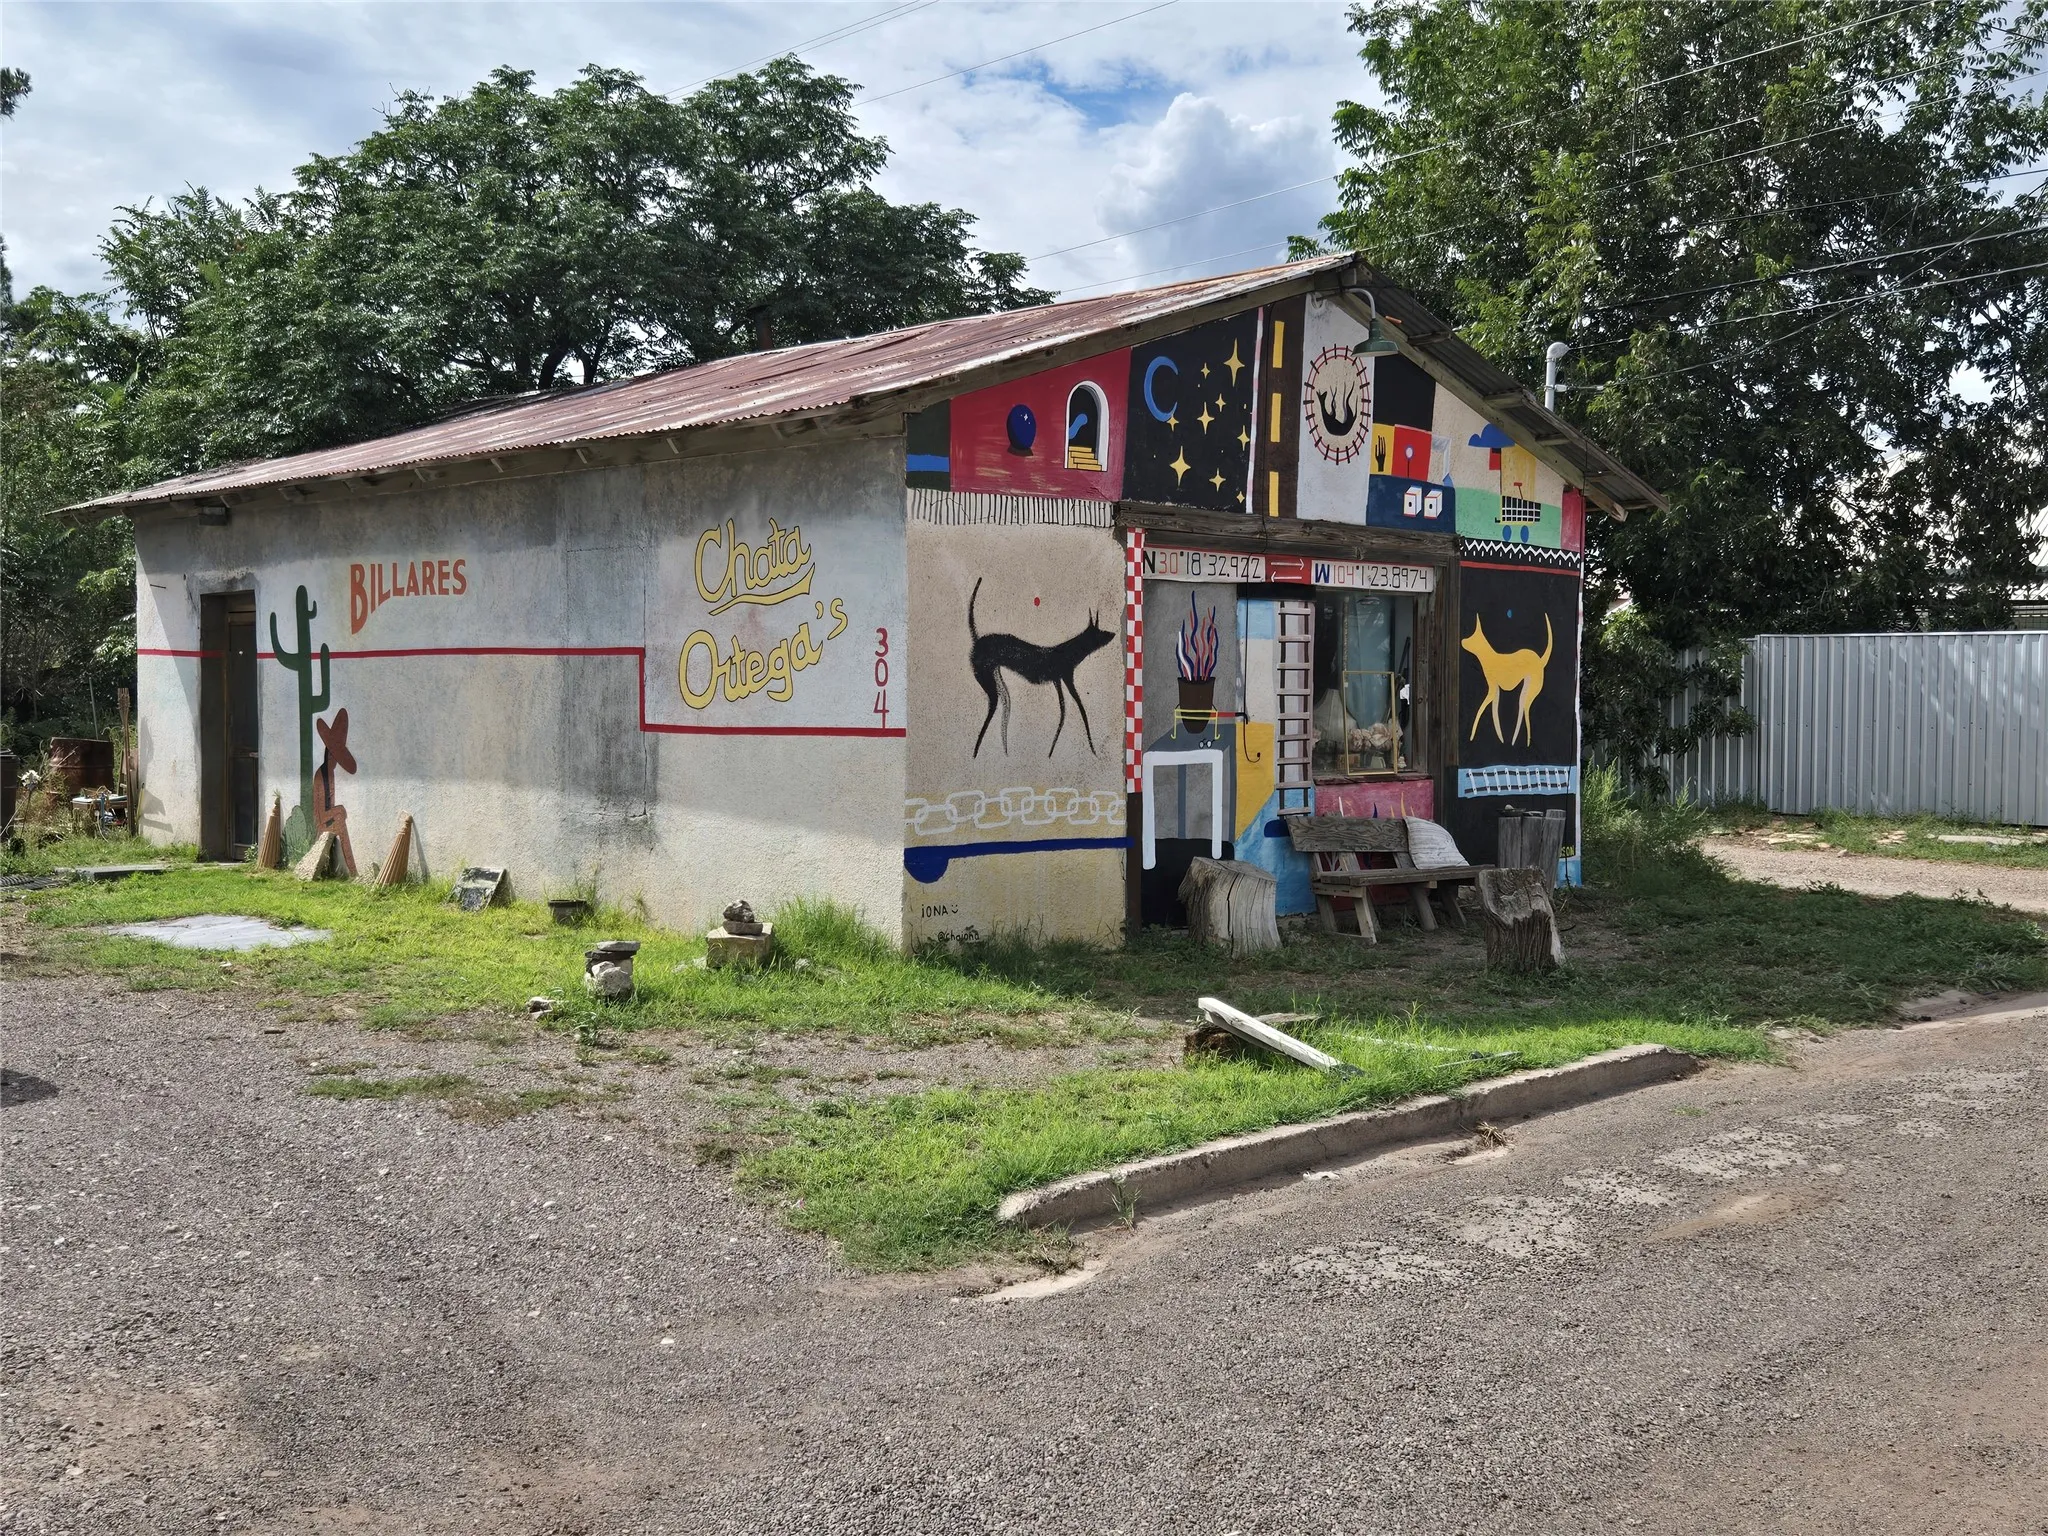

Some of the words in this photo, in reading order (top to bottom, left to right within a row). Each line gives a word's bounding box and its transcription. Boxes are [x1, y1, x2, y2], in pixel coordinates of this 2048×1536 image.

[350, 559, 467, 635] BILLARES
[694, 518, 811, 603] Chata
[678, 598, 848, 710] Ortega's
[873, 627, 890, 729] 304
